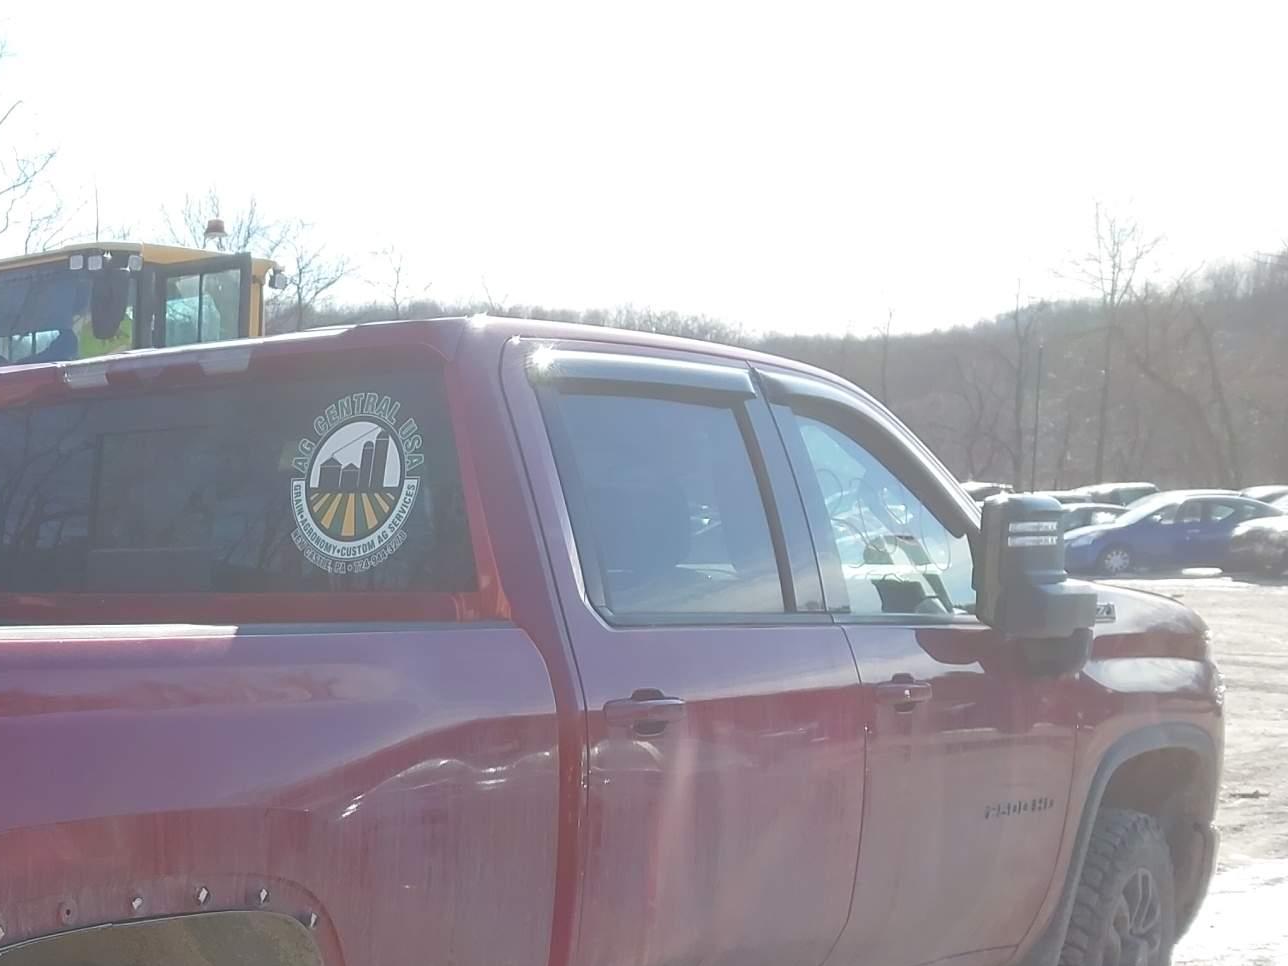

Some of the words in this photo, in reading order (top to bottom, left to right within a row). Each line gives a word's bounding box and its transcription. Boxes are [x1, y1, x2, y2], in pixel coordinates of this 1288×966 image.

[291, 438, 315, 474] AG
[314, 393, 401, 436] CENTRAL
[399, 418, 425, 472] USA
[341, 540, 376, 557] CUSTOM
[377, 530, 389, 544] AG
[388, 484, 415, 532] SERVICES
